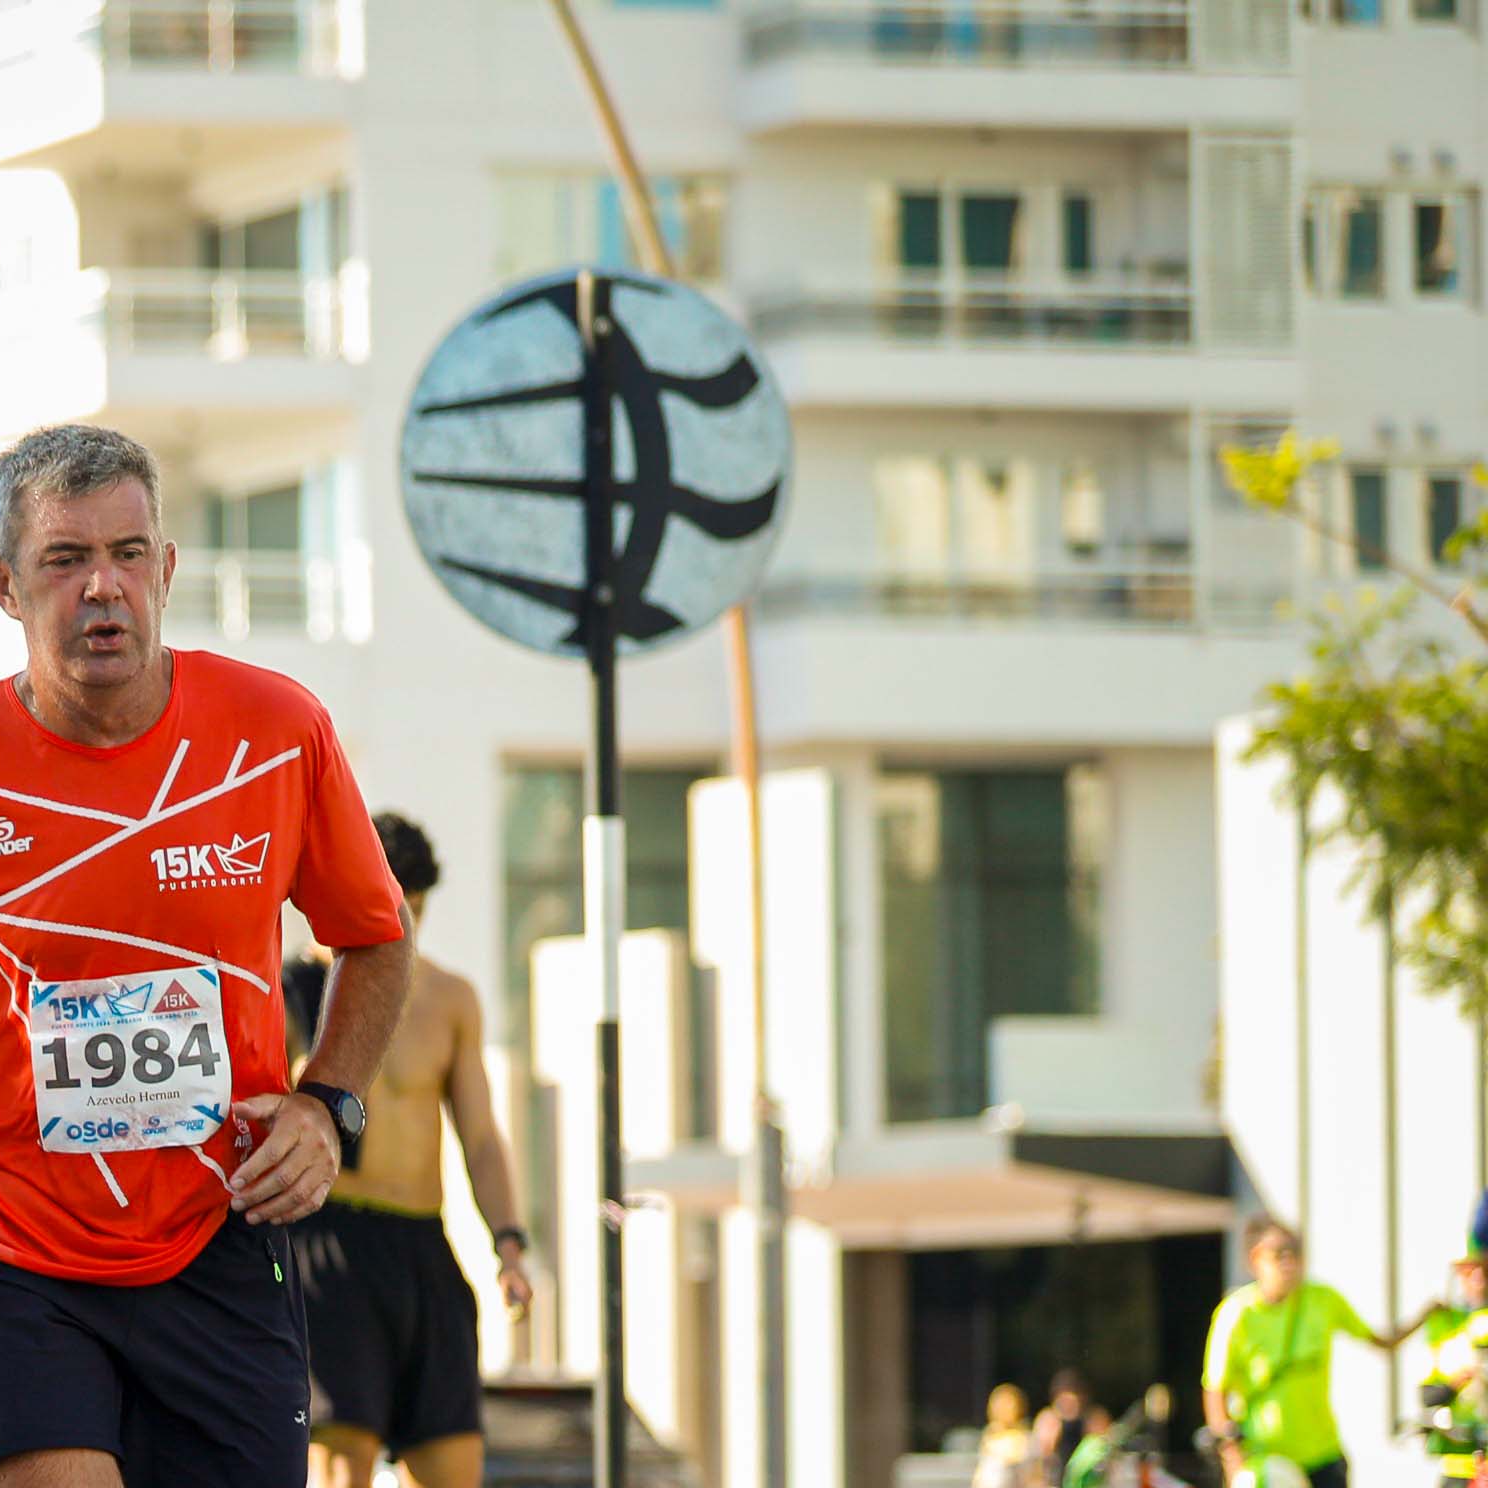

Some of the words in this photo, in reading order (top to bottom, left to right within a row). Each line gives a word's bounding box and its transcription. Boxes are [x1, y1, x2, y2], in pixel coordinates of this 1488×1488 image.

[150, 844, 216, 881] 15K
[158, 879, 217, 892] PUERTO
[221, 875, 262, 887] NORTE
[49, 994, 100, 1021] 15K
[162, 992, 190, 1008] 15K
[42, 1022, 221, 1089] 1984
[86, 1094, 136, 1107] Azevedo
[139, 1090, 180, 1103] Hernan
[66, 1115, 129, 1142] osde
